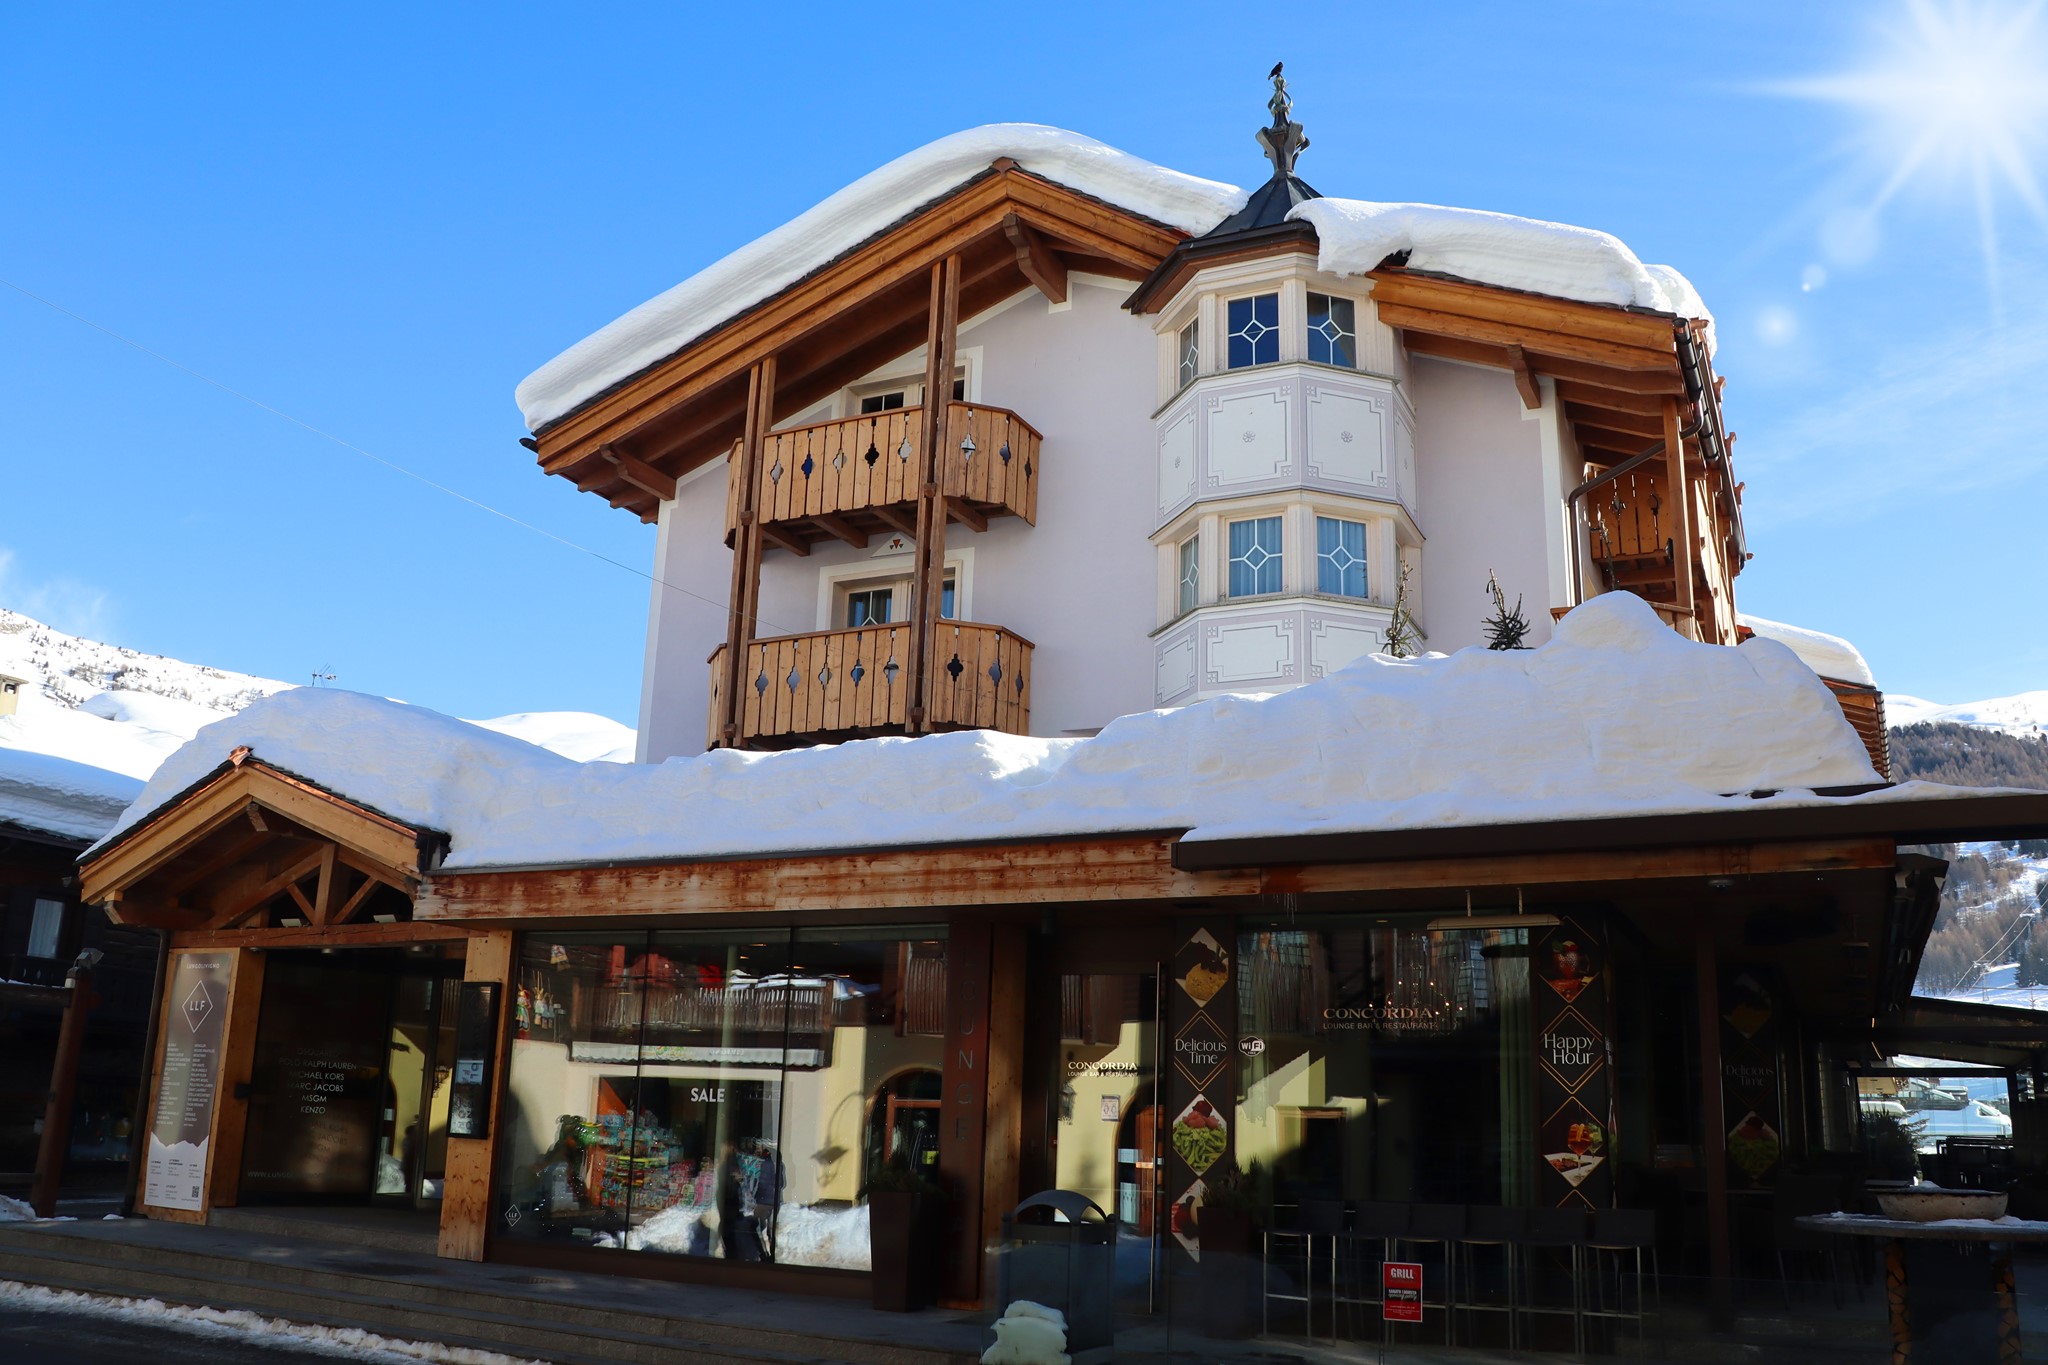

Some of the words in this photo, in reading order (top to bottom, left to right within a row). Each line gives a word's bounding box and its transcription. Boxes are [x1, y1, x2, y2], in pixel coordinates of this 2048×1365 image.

[189, 1000, 205, 1011] LLF
[1323, 1008, 1433, 1019] CONCORDIA
[1323, 1022, 1355, 1030] LOUNGE
[1175, 1037, 1227, 1052] Delicious
[1544, 1033, 1595, 1053] Happy
[1189, 1051, 1218, 1065] Time
[1552, 1048, 1595, 1065] Hour
[303, 1058, 327, 1068] RALPH
[328, 1060, 357, 1070] LAUREN
[1068, 1061, 1138, 1070] CONCORDIA
[289, 1070, 323, 1080] MICHAEL
[325, 1072, 345, 1082] KORS
[288, 1082, 312, 1091] MARC
[313, 1083, 344, 1093] JACOBS
[302, 1094, 327, 1103] MSGM
[690, 1087, 726, 1103] SALE
[300, 1106, 326, 1114] KENZO
[1390, 1268, 1414, 1279] GRILL
